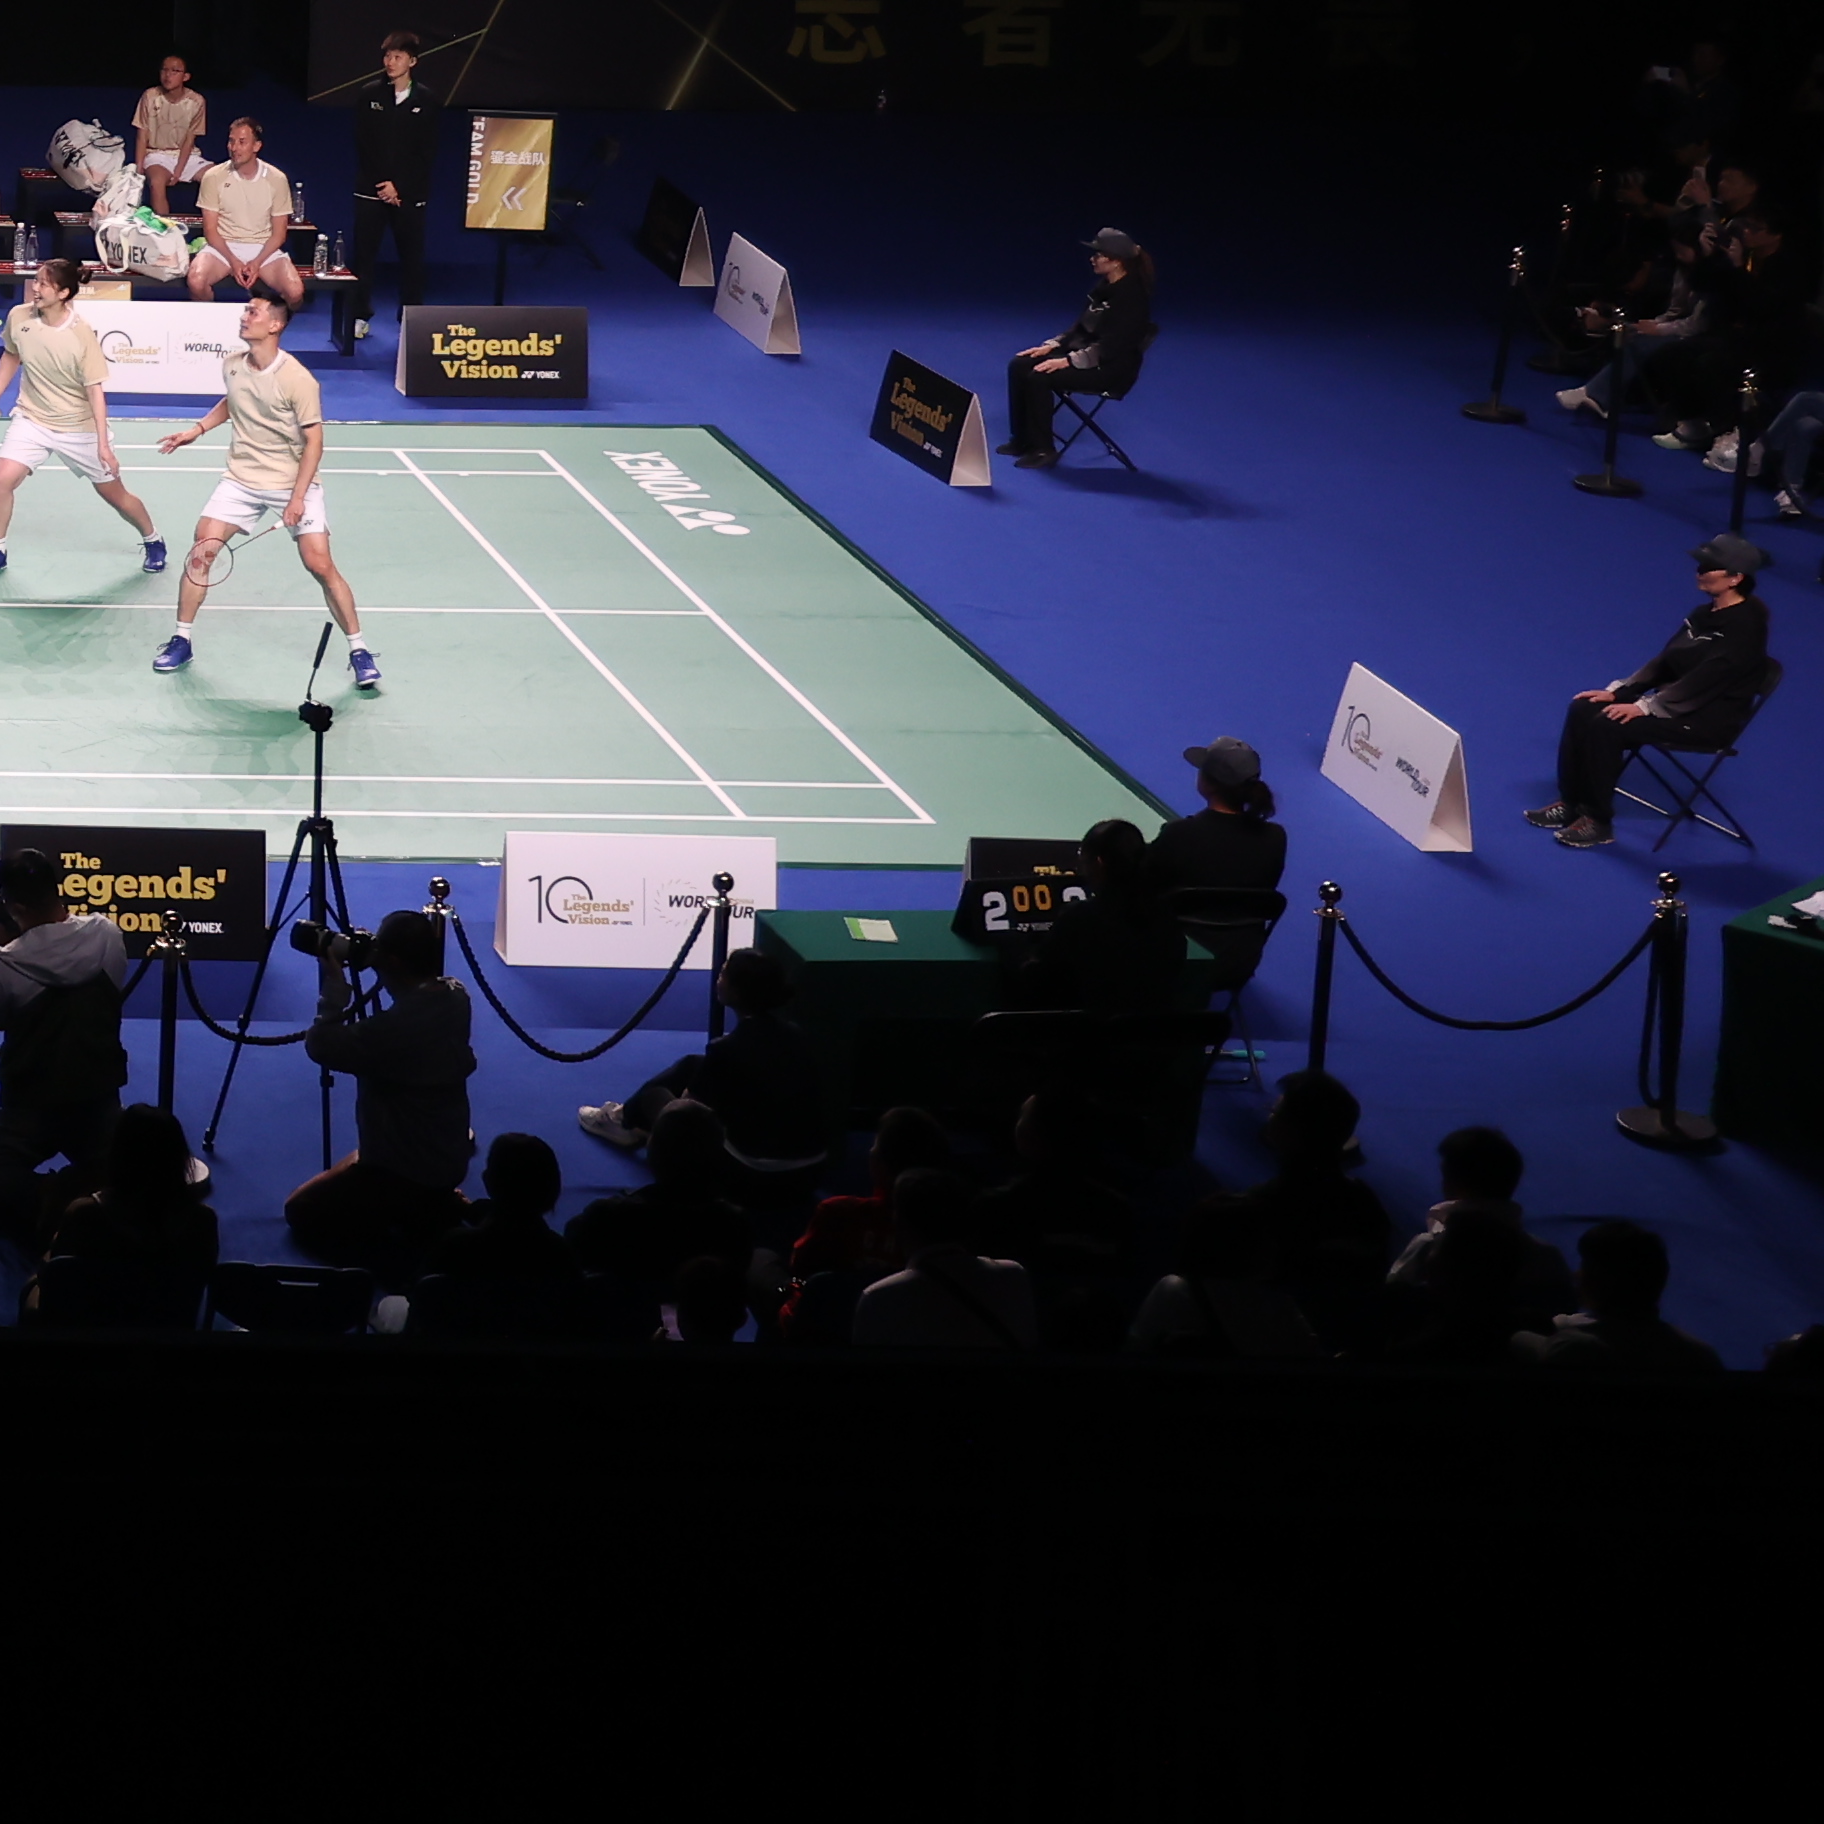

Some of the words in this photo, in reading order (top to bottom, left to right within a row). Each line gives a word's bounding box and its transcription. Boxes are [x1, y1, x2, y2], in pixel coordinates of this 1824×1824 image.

[447, 324, 477, 336] The
[184, 342, 222, 353] WORLD
[432, 332, 562, 361] Legends'
[440, 359, 519, 379] Vision
[536, 370, 561, 379] YONEX
[602, 450, 711, 502] YONEX
[60, 851, 102, 870] The
[57, 865, 227, 906] egends'
[981, 889, 1011, 932] 2
[188, 921, 224, 934] YONEX
